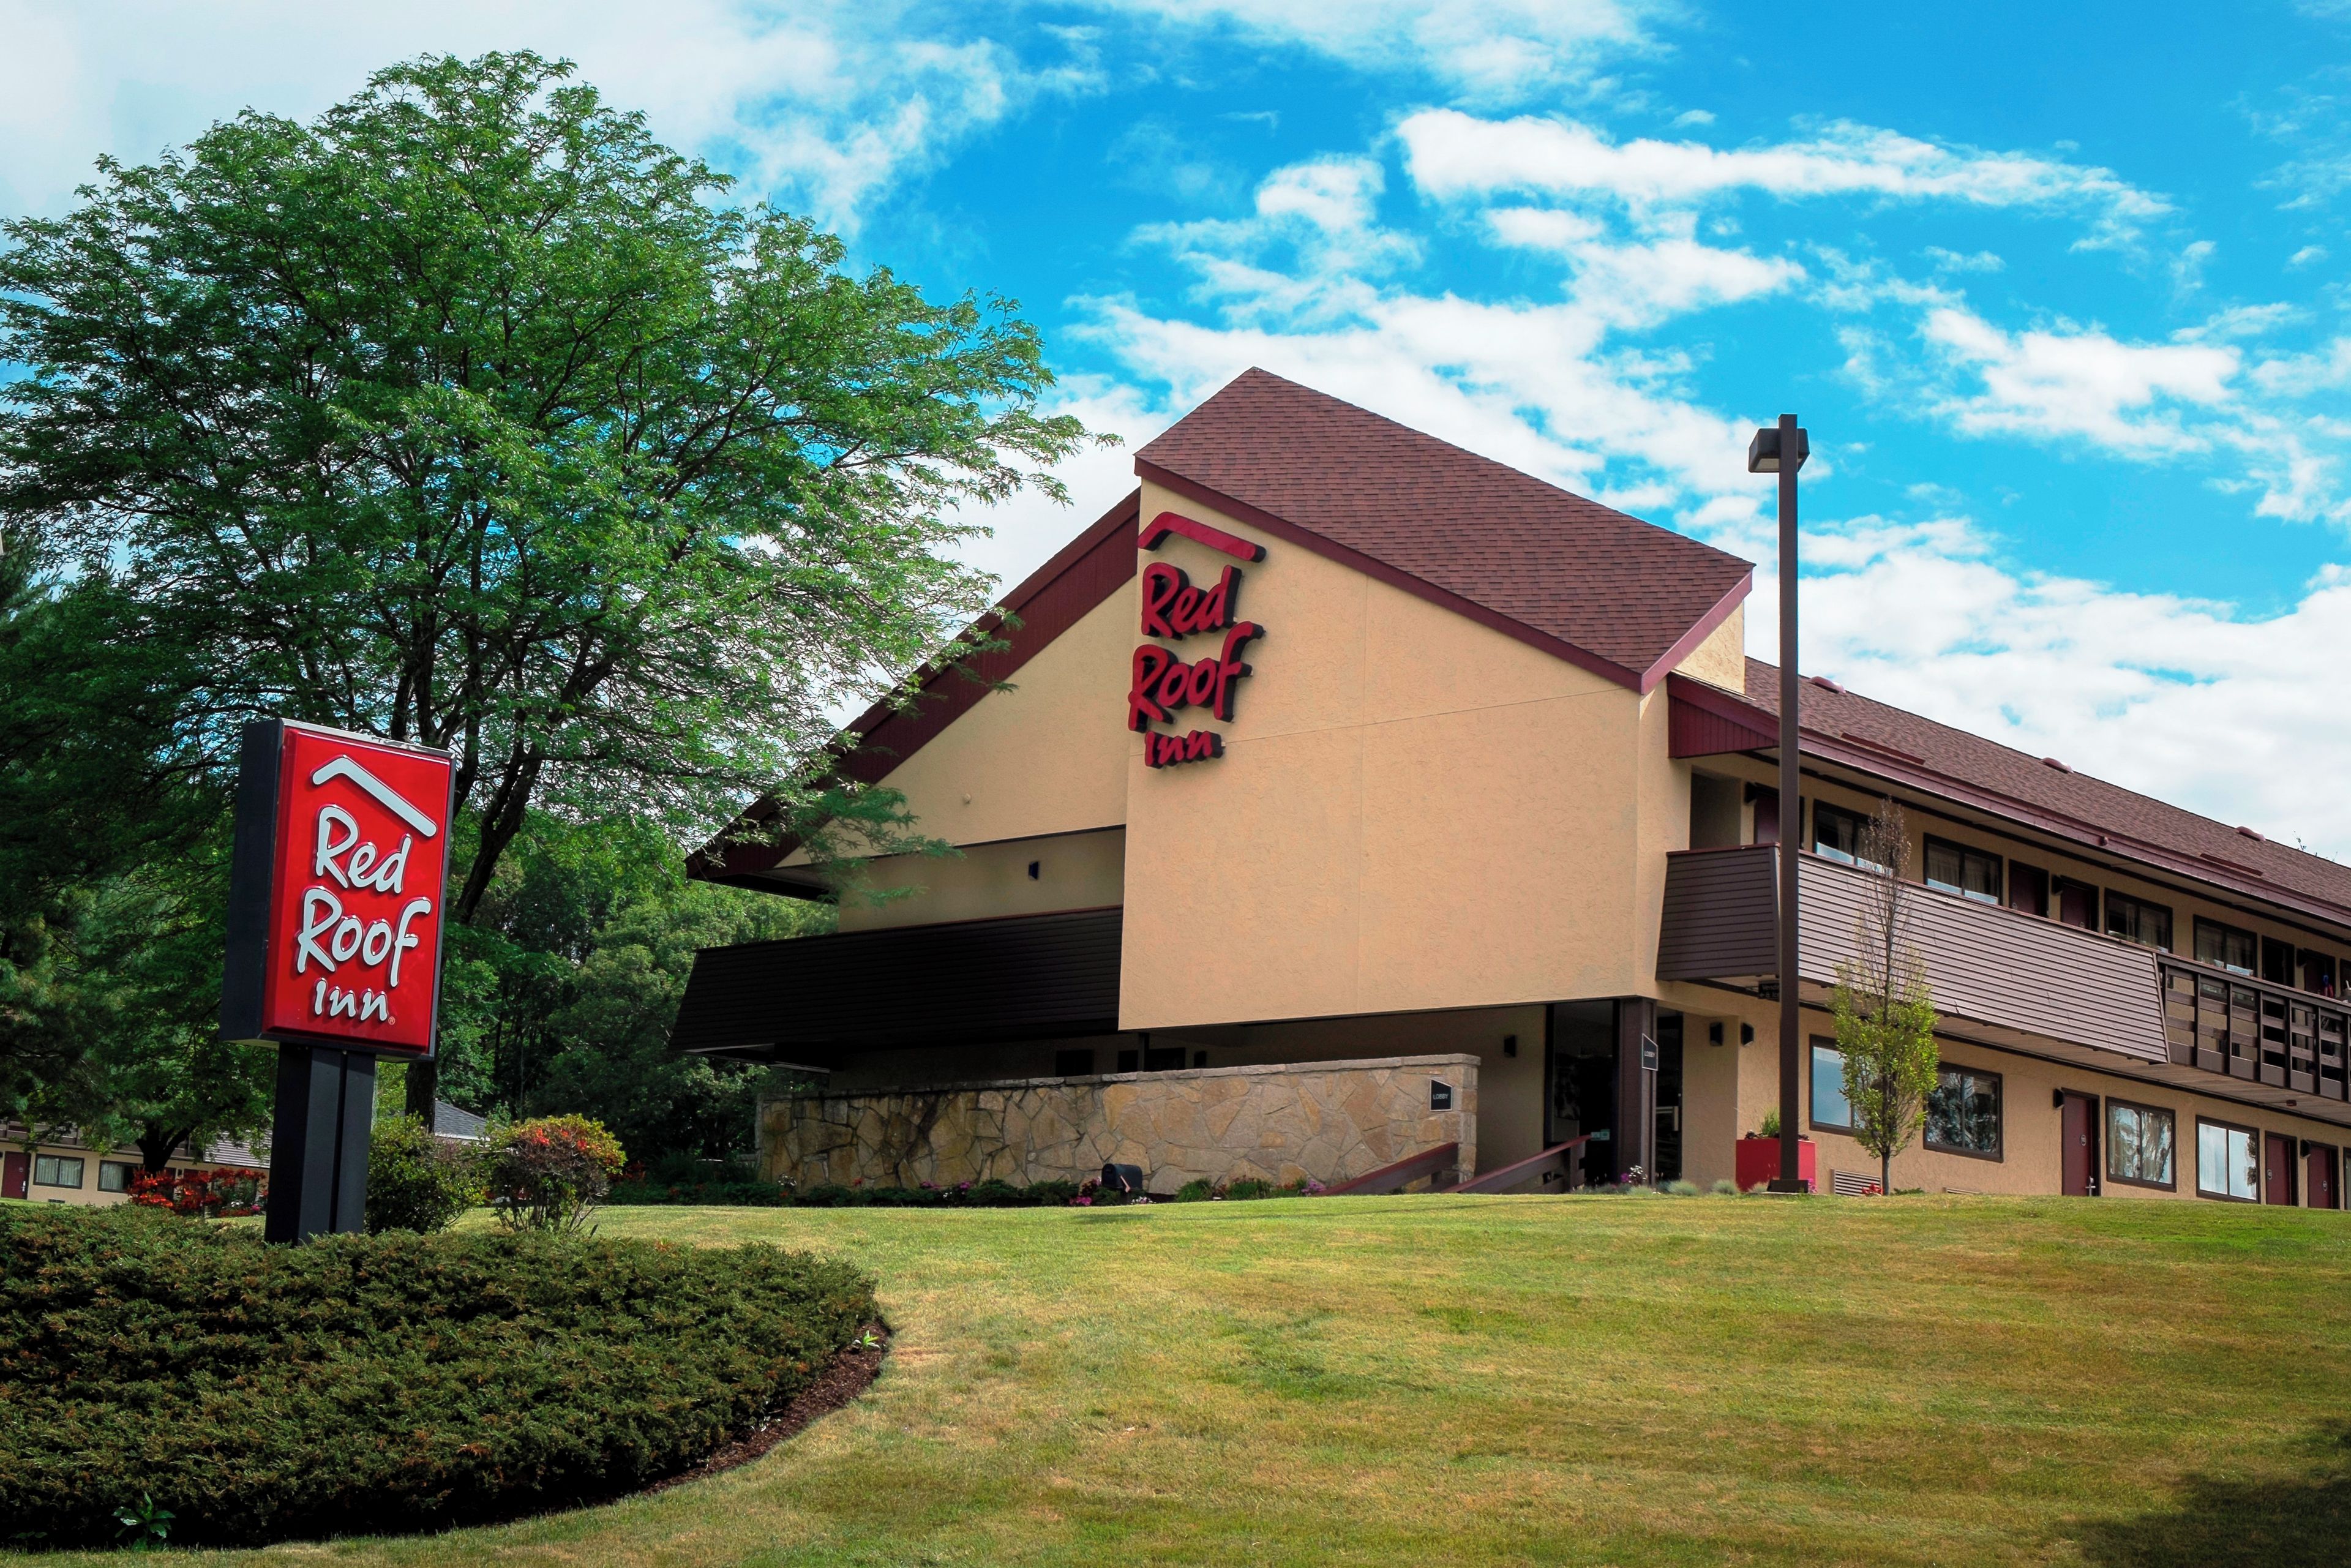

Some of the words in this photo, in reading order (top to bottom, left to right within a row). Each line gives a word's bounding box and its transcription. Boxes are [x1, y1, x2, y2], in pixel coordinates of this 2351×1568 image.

[1141, 562, 1242, 640] Red
[1128, 621, 1265, 732] Roof
[312, 804, 411, 895] Red
[296, 885, 432, 988] Roof
